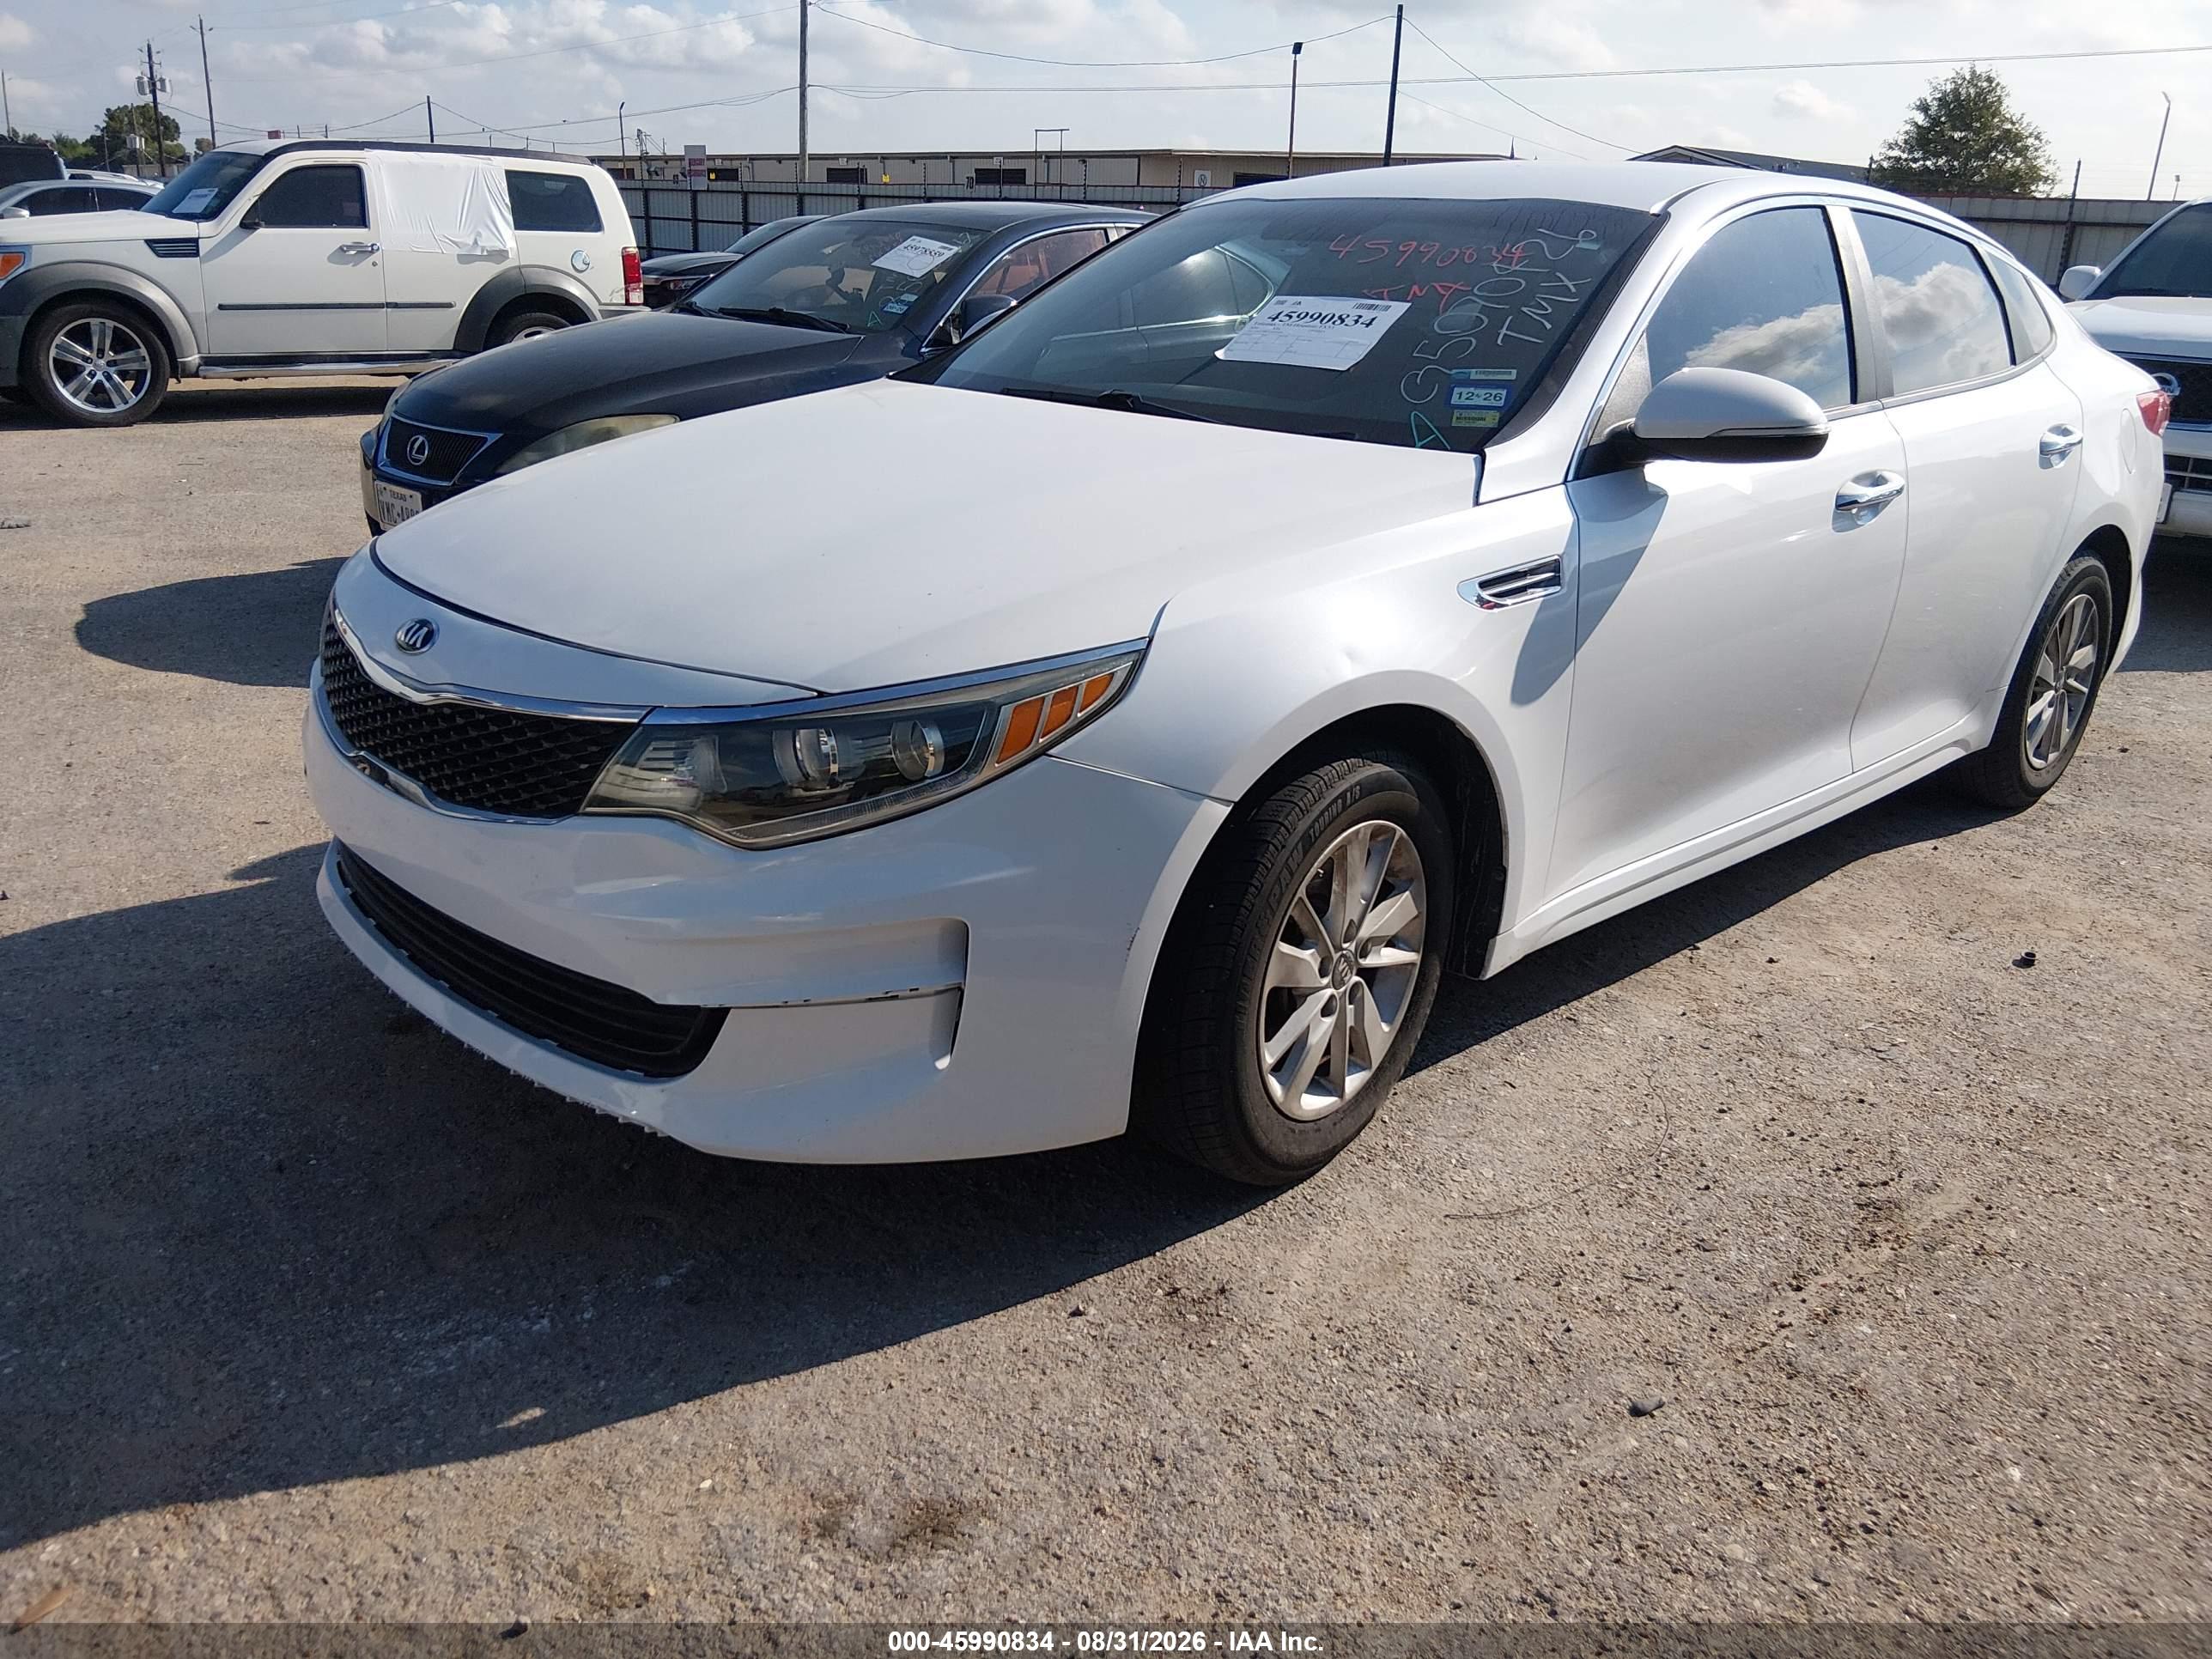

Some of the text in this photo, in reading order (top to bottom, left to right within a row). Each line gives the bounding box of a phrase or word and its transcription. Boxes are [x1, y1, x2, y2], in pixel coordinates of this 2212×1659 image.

[1267, 309, 1378, 329] 45990834
[1497, 271, 1592, 346] TMX
[1409, 410, 1451, 450] A
[1267, 841, 1304, 915] PAW
[1310, 798, 1343, 843] TOURING
